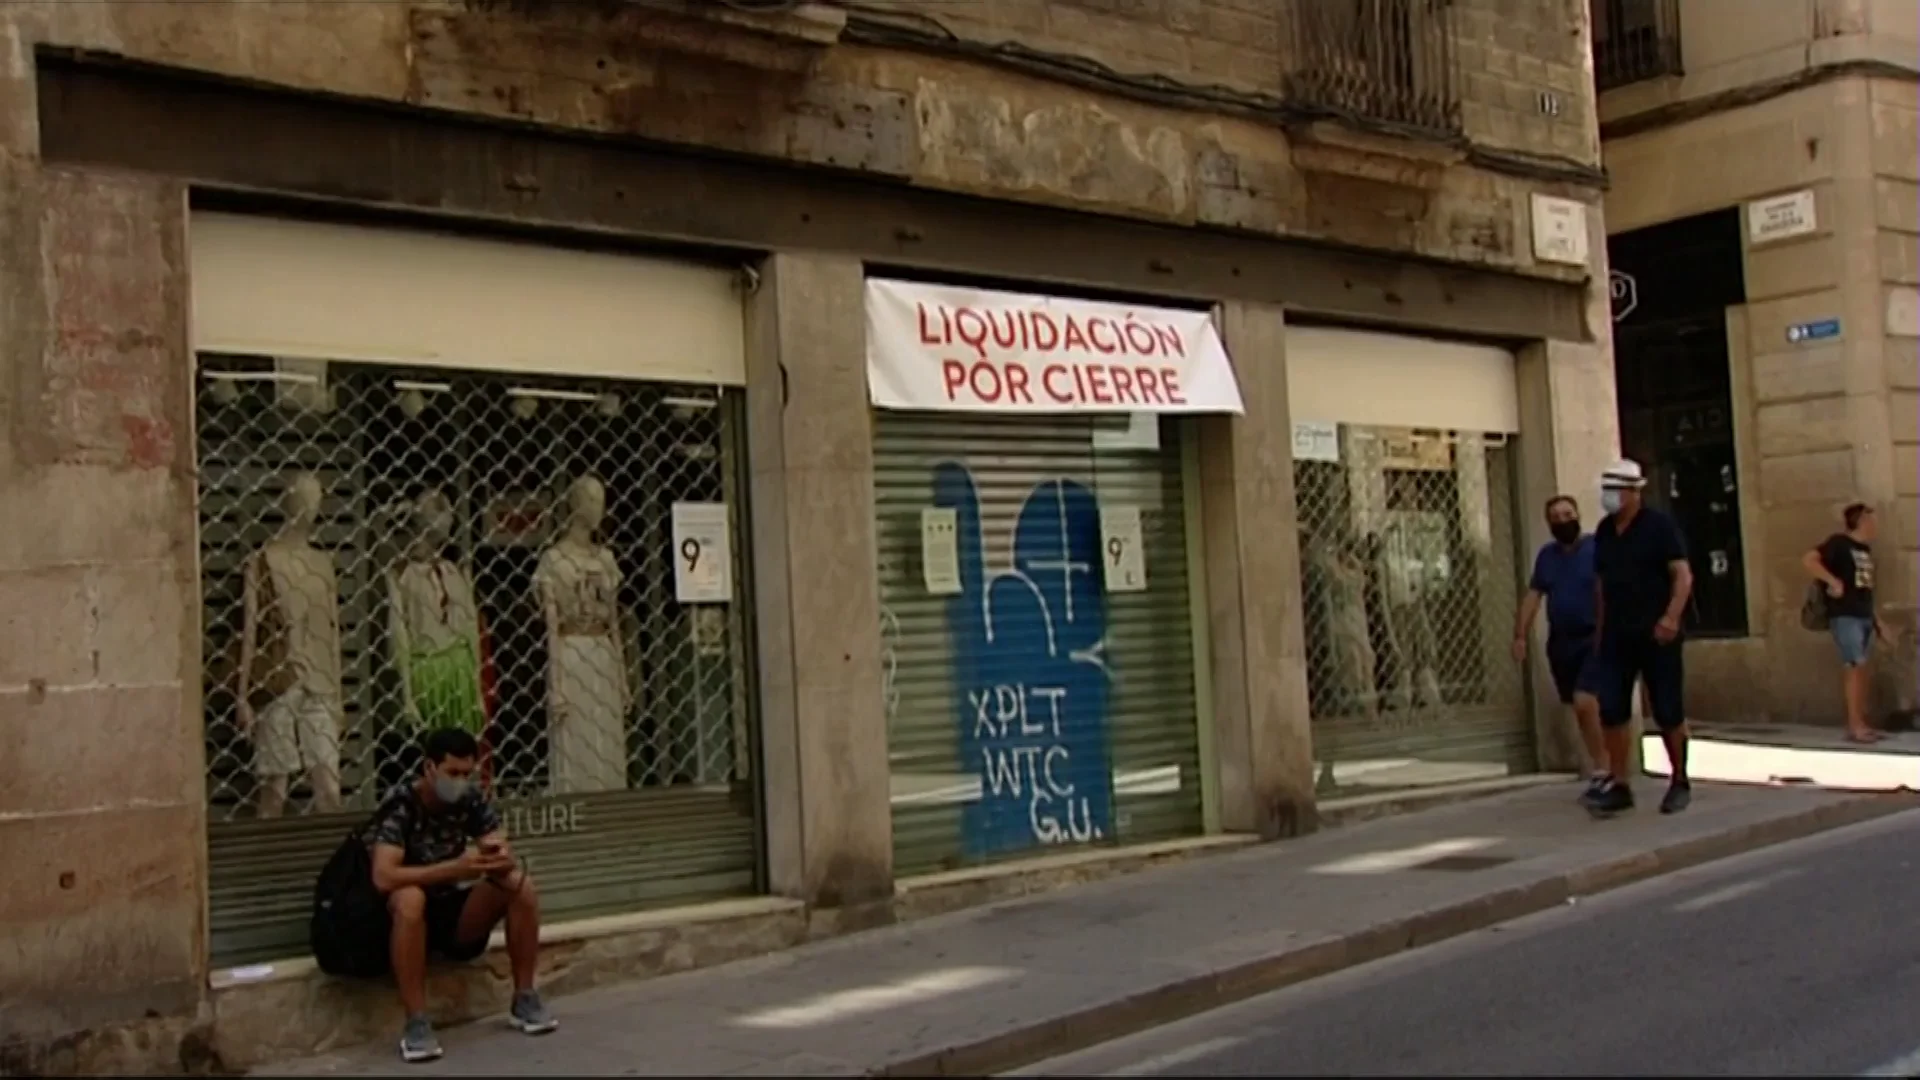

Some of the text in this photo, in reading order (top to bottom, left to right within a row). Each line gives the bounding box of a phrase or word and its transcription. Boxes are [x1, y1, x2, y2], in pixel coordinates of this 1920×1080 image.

[918, 301, 1185, 359] LIQUIDACIÓN
[943, 358, 1187, 405] POR CIERRE
[968, 683, 1066, 739] XPLT
